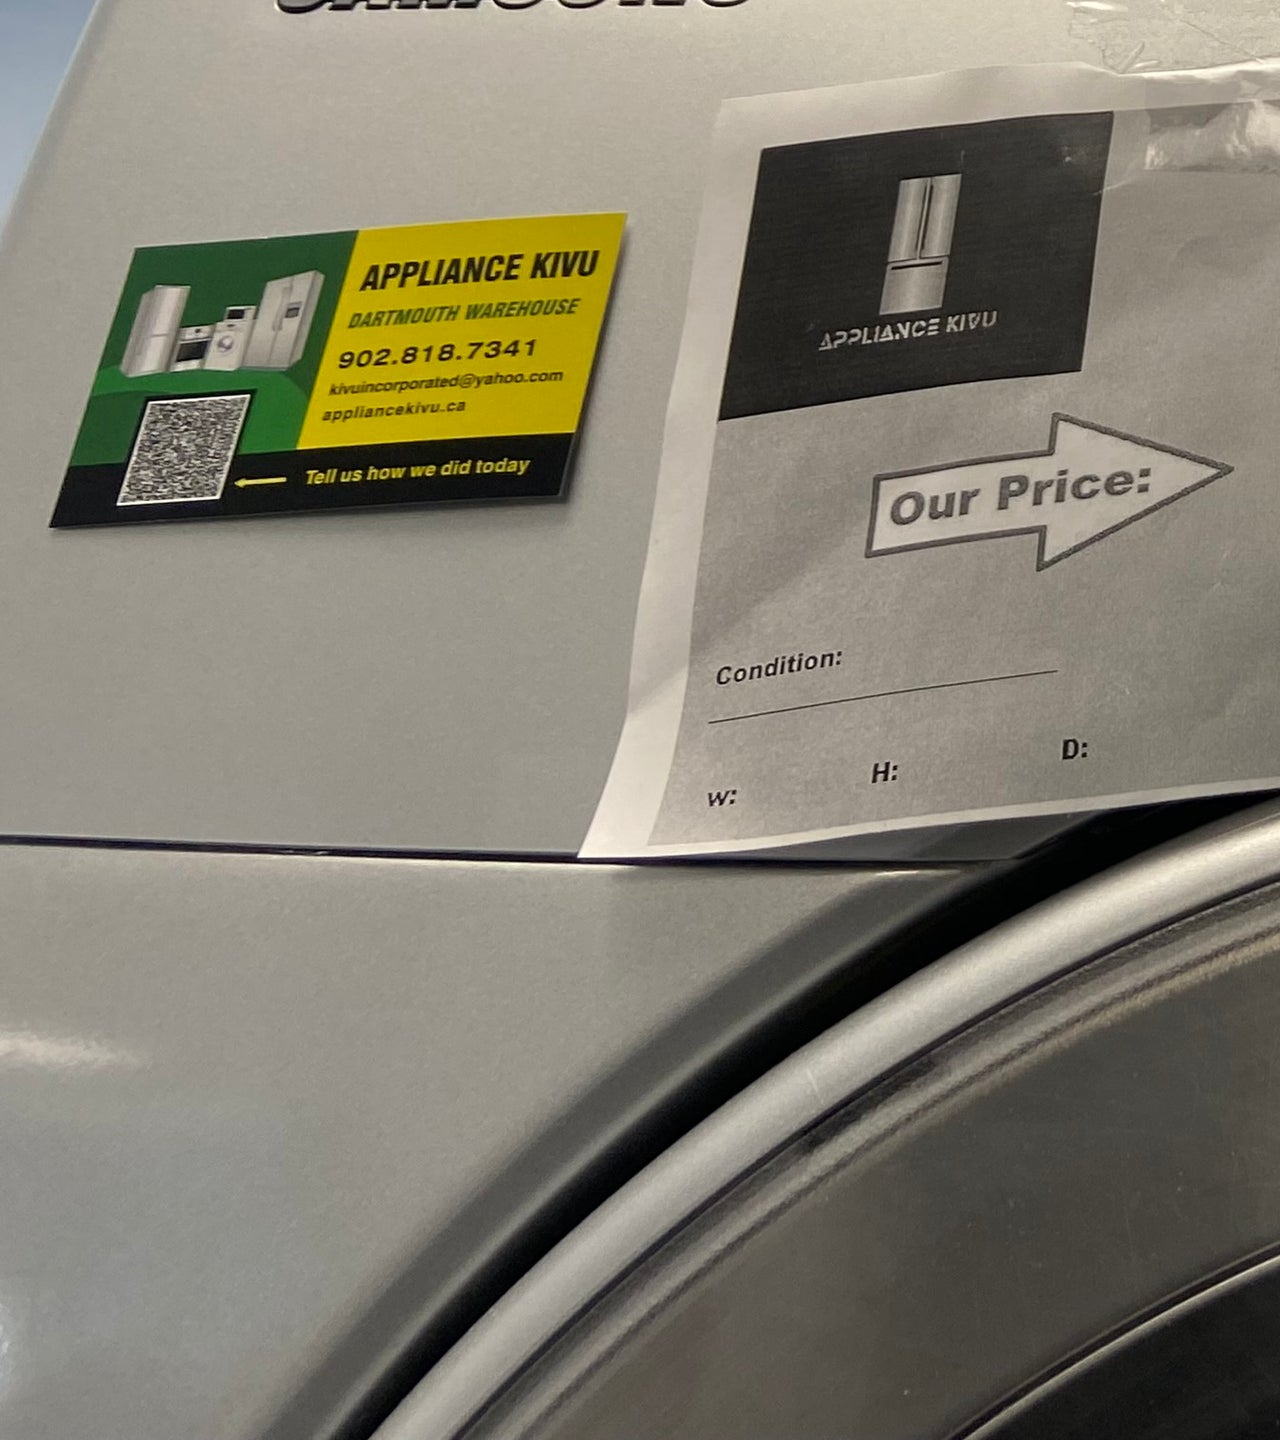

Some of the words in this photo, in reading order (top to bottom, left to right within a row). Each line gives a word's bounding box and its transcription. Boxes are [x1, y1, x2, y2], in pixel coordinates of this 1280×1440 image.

[359, 254, 524, 292] APPLIANCE
[530, 250, 600, 278] KIVU
[348, 304, 460, 329] DARTMOUTH
[464, 298, 581, 321] WAREHOUSE
[818, 317, 941, 352] APPLIANCE
[945, 310, 998, 335] KIVU
[337, 339, 538, 369] 902.818.7341
[329, 369, 564, 398] kivuincorporated@yahoo.com
[322, 399, 466, 423] appliancekivu.ca
[306, 467, 337, 486] Tell
[341, 469, 361, 484] us
[366, 464, 405, 482] how
[410, 465, 437, 480] we
[443, 460, 471, 479] did
[476, 457, 531, 480] today
[890, 486, 980, 526] Our
[996, 467, 1152, 511] Price:
[716, 649, 843, 686] Condition:
[1062, 738, 1089, 761] D:
[871, 762, 899, 784] H:
